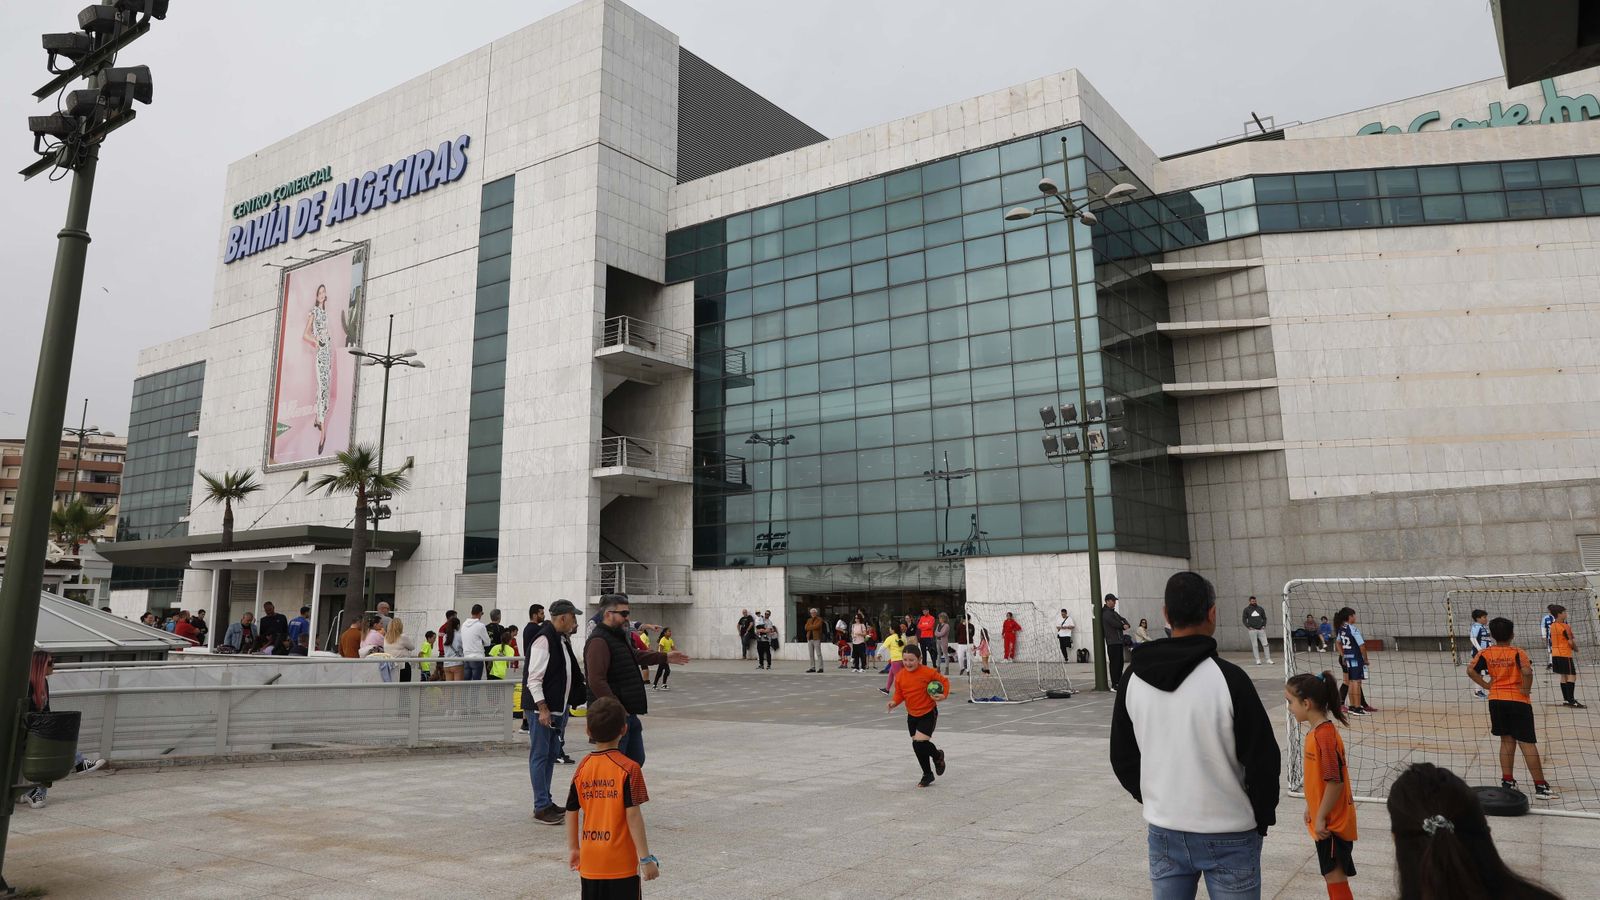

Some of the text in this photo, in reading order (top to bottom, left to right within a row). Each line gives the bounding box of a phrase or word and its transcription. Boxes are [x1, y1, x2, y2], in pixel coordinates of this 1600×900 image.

[224, 134, 470, 264] BAHÍA DE ALGECIRAS
[232, 165, 333, 219] CENTRO COMERCIAL
[582, 779, 615, 789] BALNMANO
